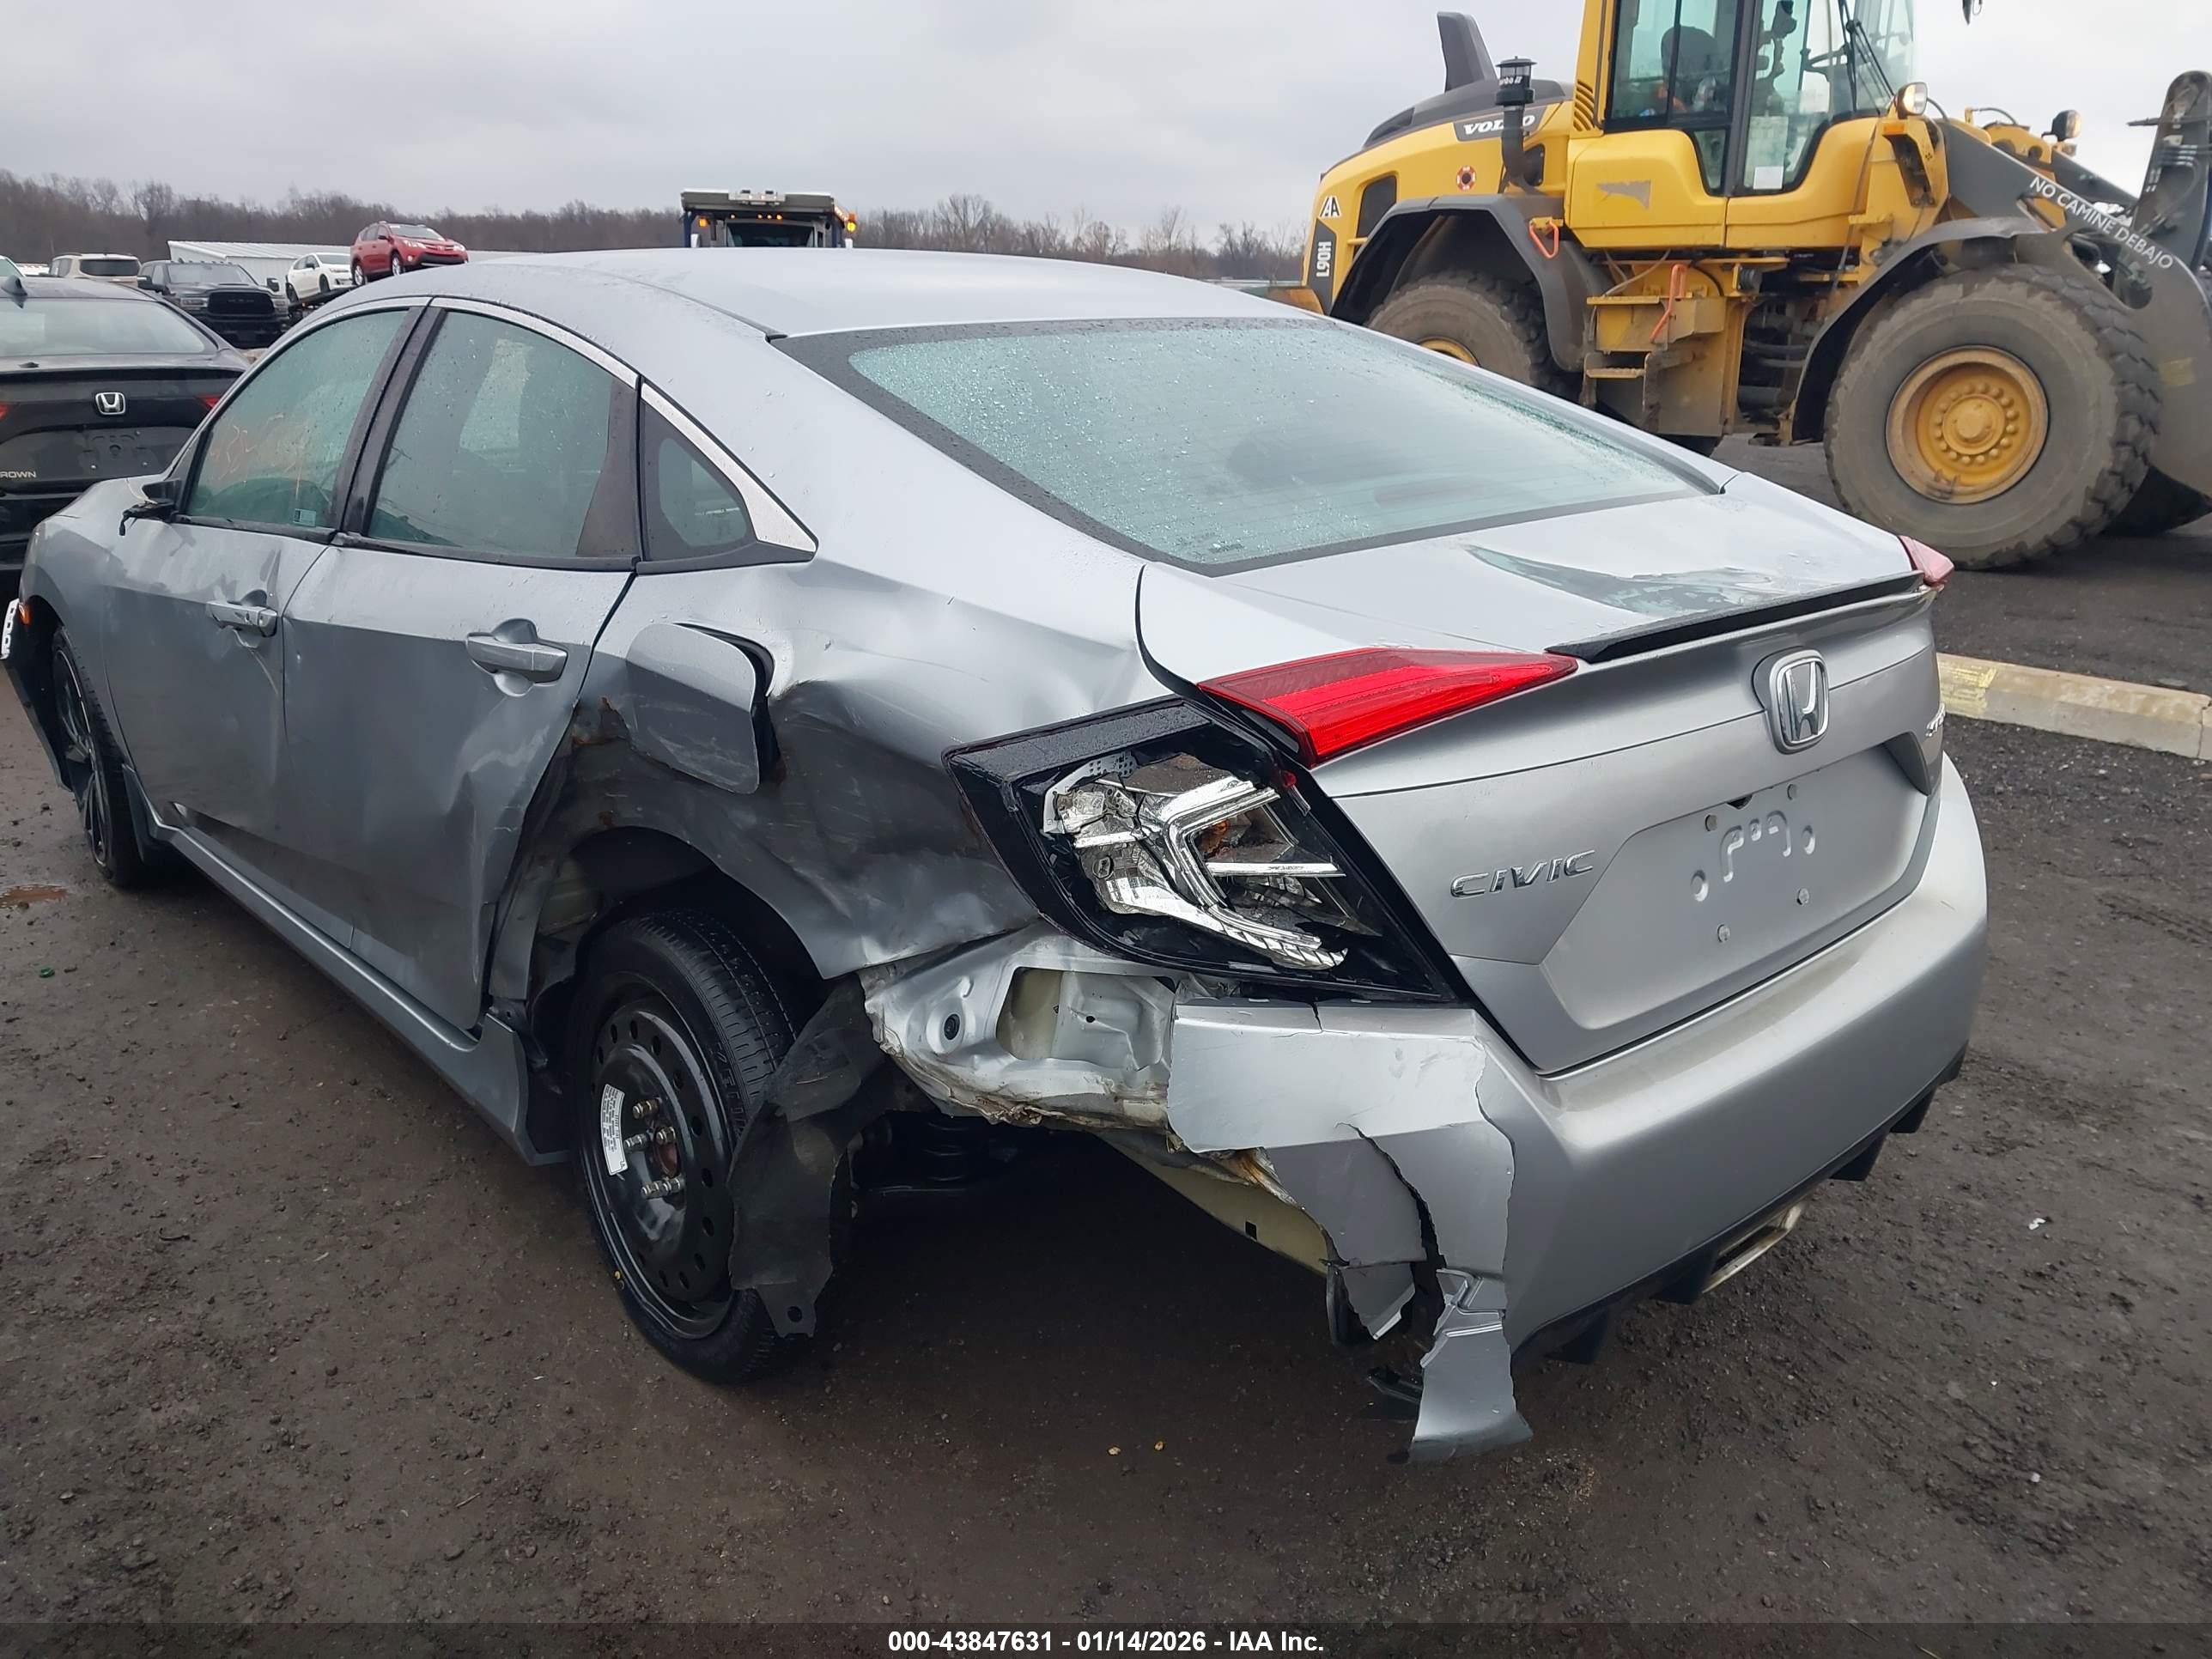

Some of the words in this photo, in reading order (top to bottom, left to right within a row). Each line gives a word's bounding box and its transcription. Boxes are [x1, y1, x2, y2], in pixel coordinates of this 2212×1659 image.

[1463, 115, 1535, 135] VOLO
[2029, 176, 2057, 198] NO
[2057, 193, 2116, 234] CAMINE
[2114, 227, 2173, 268] DEBAJO
[1316, 241, 1333, 277] L90H
[1450, 849, 1595, 898] CIVIC
